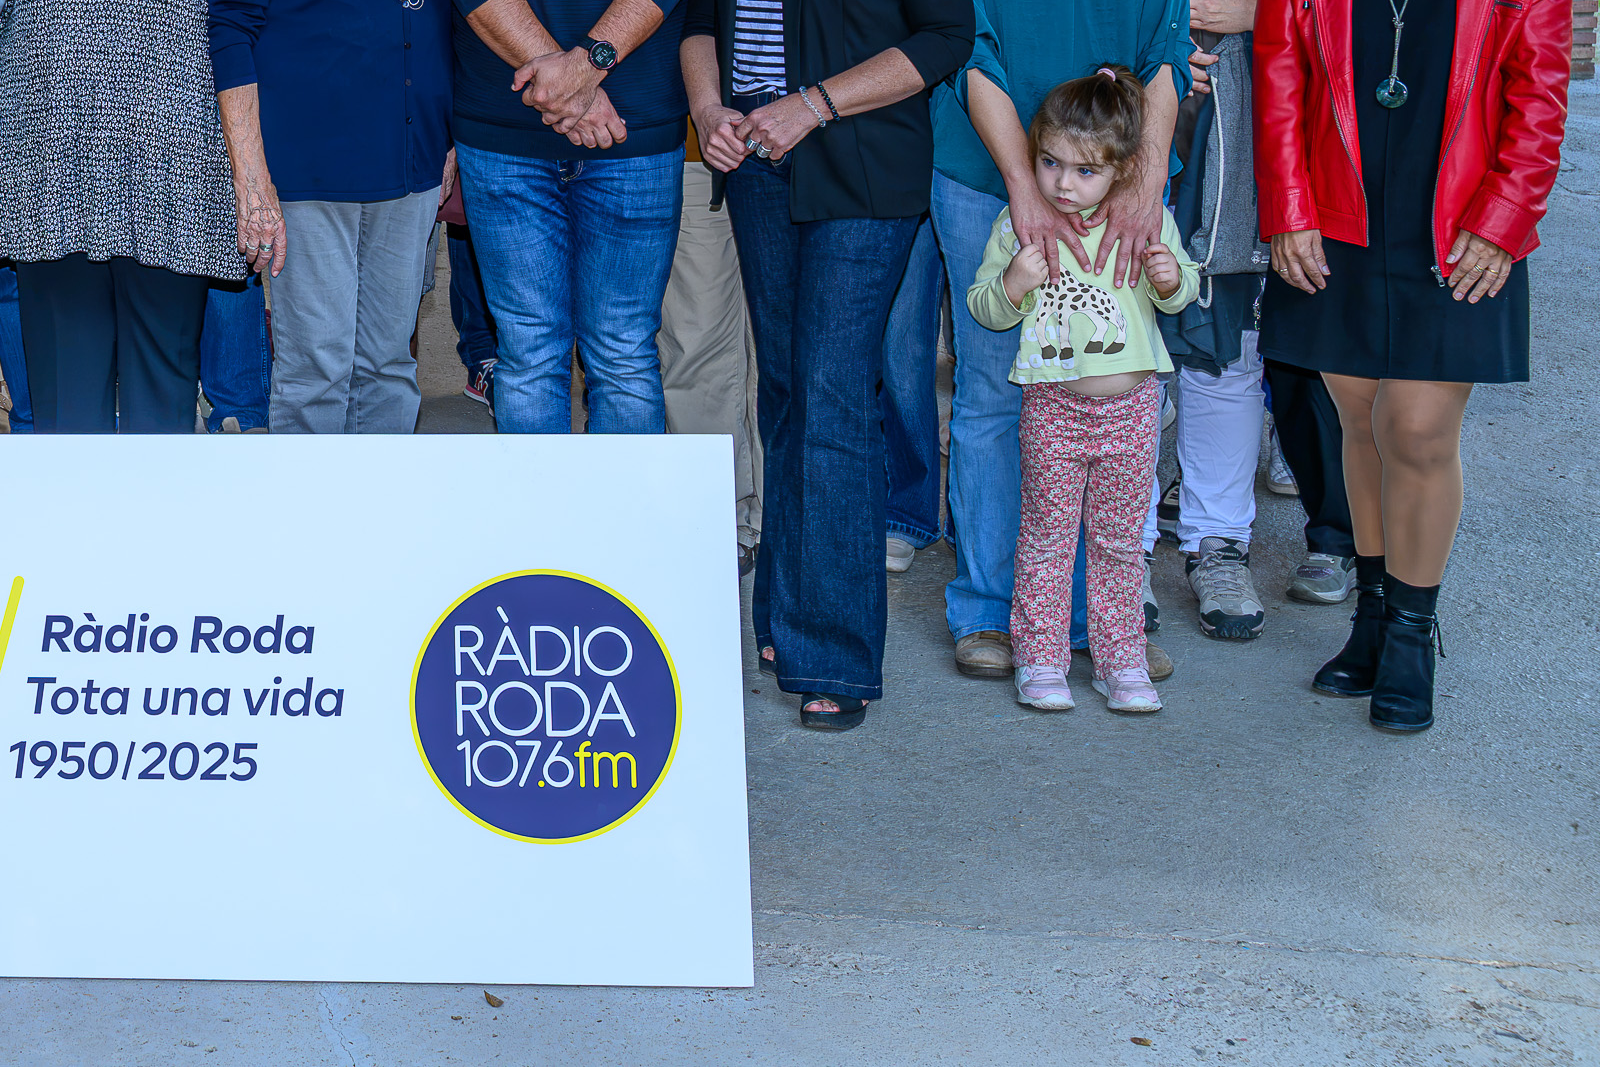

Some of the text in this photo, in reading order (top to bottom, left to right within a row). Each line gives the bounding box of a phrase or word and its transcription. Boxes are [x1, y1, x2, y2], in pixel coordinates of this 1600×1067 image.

[41, 612, 316, 655] Ràdio Roda
[454, 605, 633, 677] RÀDIO
[26, 675, 345, 718] Tota una vida
[455, 680, 636, 738] RODA
[9, 740, 259, 782] 1950/2025
